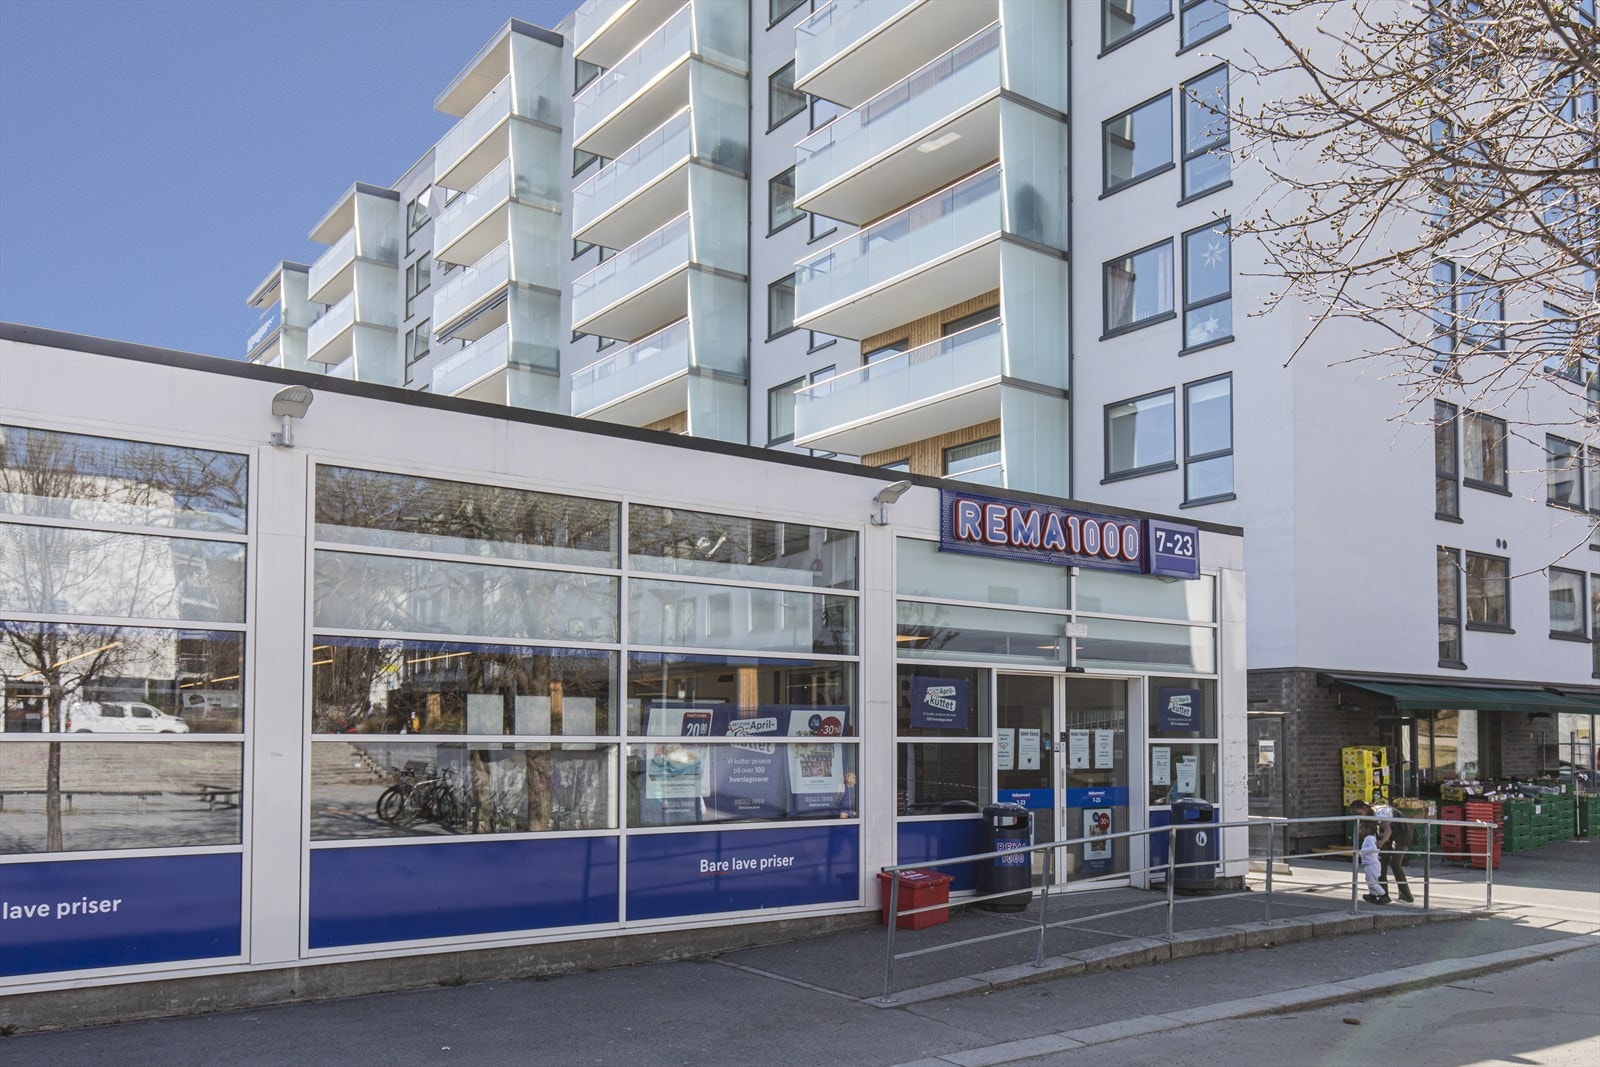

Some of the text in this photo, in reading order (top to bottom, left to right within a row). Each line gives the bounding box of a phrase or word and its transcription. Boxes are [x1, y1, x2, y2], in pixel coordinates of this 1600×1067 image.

[1156, 531, 1193, 556] 7-23
[930, 694, 954, 710] kuttet
[750, 720, 775, 731] April-
[820, 724, 841, 735] -30%
[729, 776, 769, 784] hverdagsvarer
[700, 854, 795, 873] Bare lave priser
[2, 896, 122, 920] lave priser
